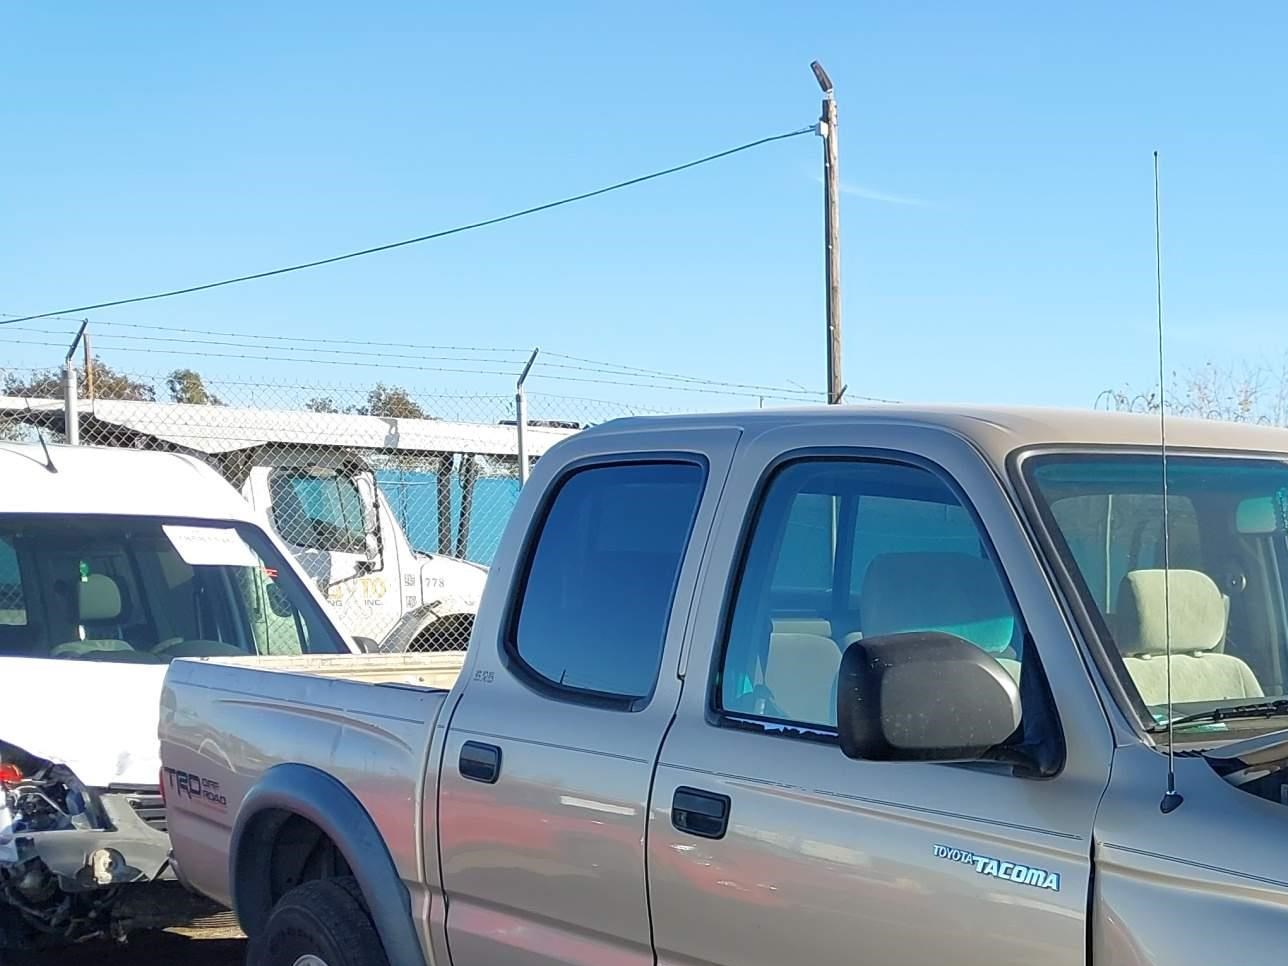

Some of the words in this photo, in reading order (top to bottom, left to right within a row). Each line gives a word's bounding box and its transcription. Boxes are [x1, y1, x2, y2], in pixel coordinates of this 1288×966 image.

[163, 766, 202, 800] TRD
[932, 844, 975, 865] TOYOTA
[973, 854, 1061, 891] TACOMA
